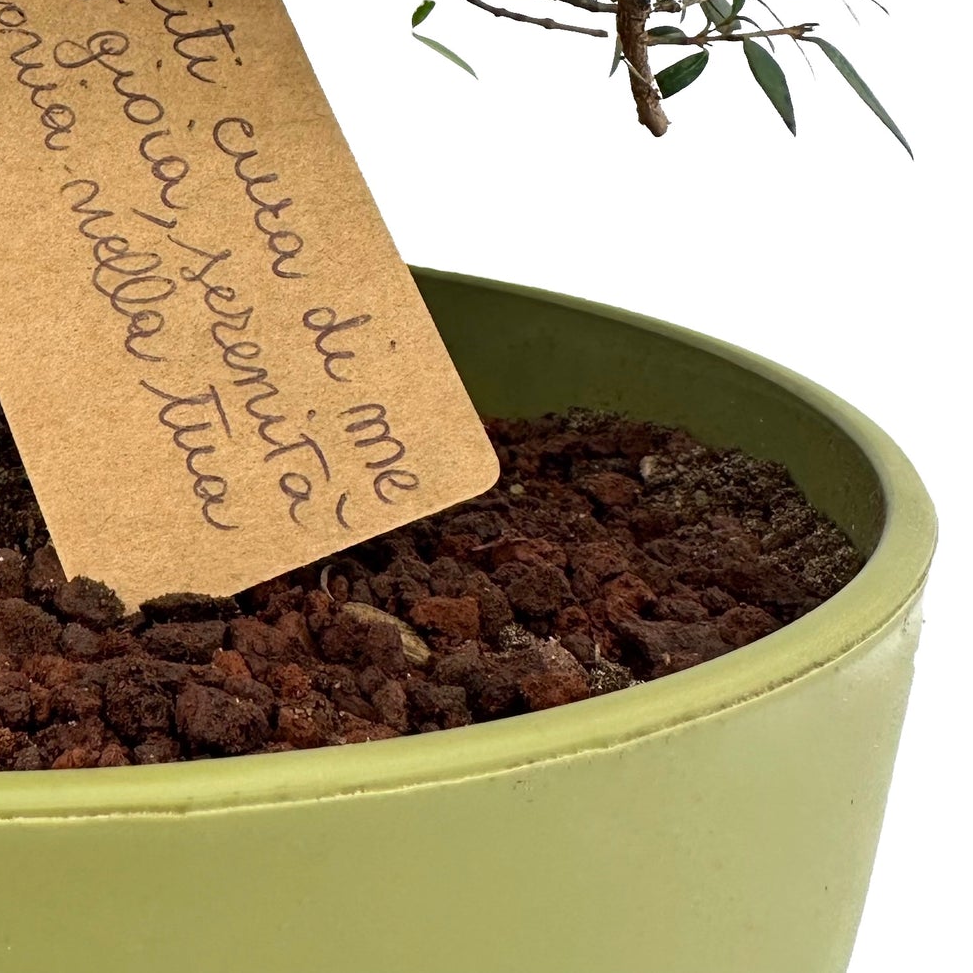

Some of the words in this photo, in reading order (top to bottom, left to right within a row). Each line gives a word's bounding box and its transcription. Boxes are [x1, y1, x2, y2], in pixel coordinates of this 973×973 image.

[213, 117, 308, 278] cura
[54, 30, 195, 228] gioia,
[168, 234, 352, 528] serenità
[61, 179, 176, 362] nella
[140, 380, 239, 530] tua
[303, 307, 396, 382] di
[338, 403, 420, 504] me
